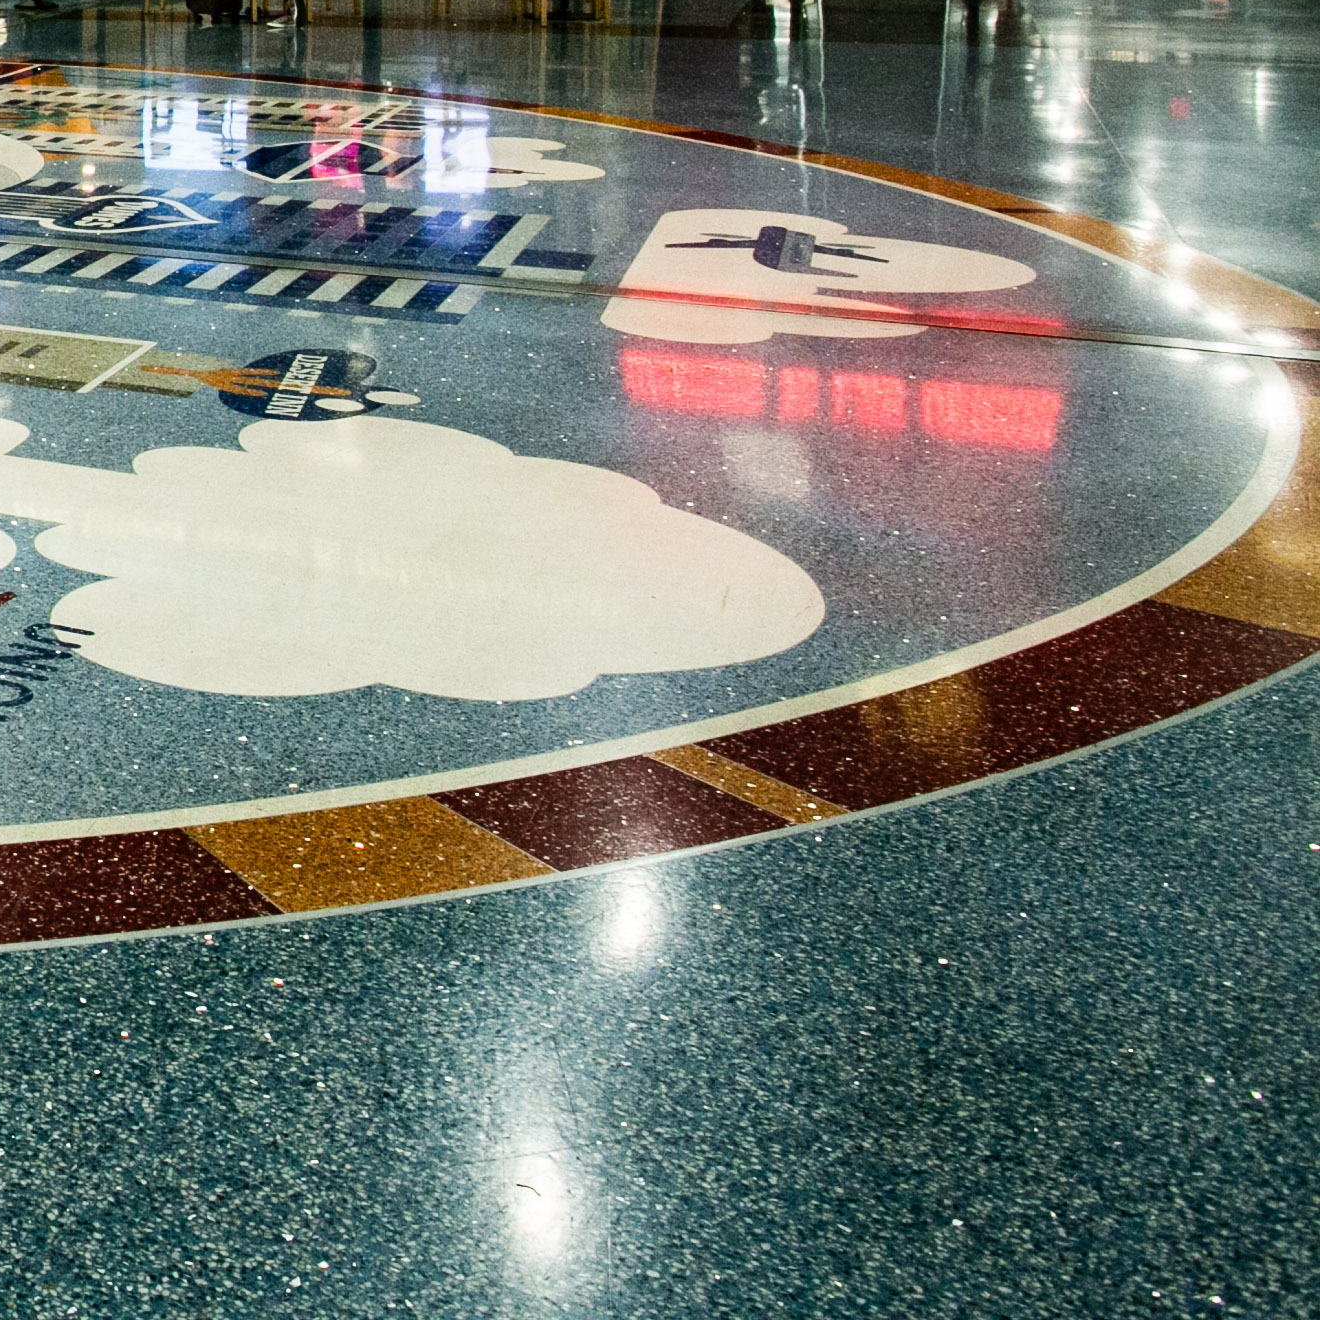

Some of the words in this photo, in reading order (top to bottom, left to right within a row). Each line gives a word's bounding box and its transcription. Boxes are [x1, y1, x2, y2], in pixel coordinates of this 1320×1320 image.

[74, 201, 159, 228] DUNES
[278, 353, 328, 394] DESERT
[265, 392, 309, 418] INN
